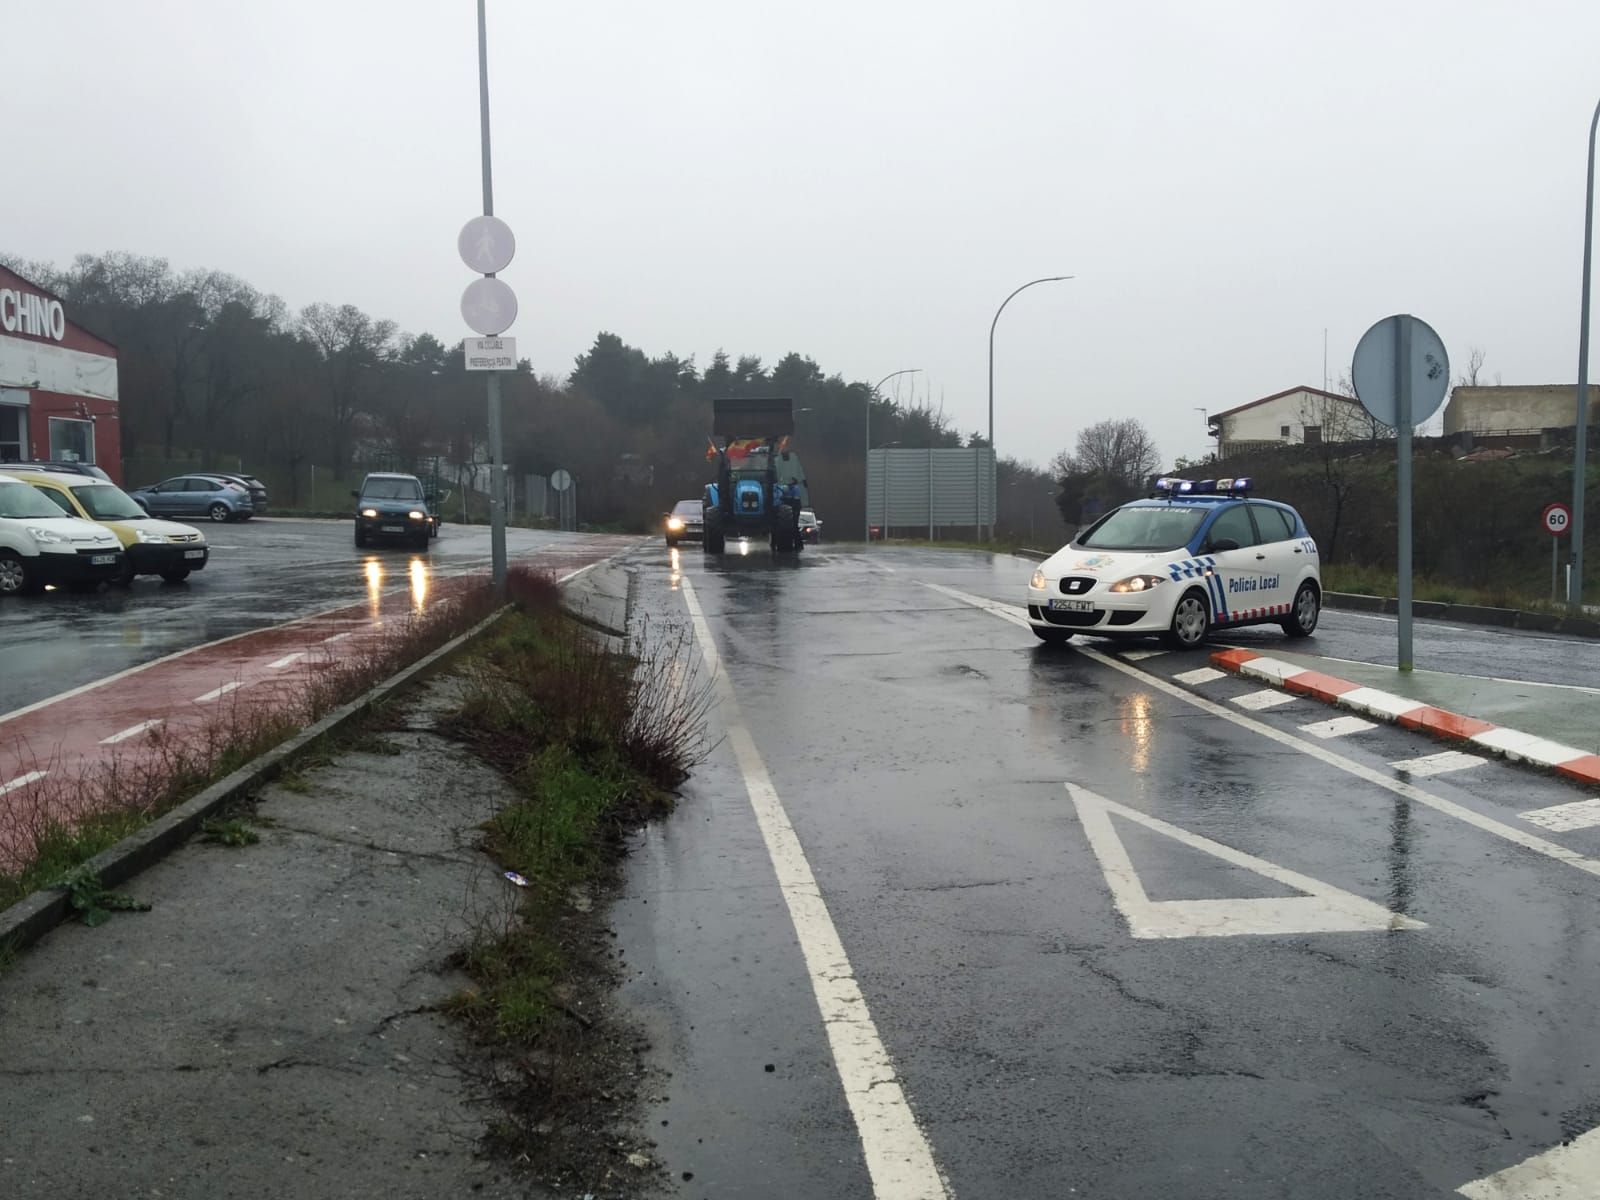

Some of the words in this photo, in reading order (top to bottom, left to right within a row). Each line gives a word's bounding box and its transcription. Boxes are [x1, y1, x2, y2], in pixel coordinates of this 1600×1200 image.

[0, 288, 65, 341] CHINO
[1549, 514, 1565, 525] 60
[1301, 541, 1316, 553] 112
[1229, 576, 1257, 593] Policía
[1259, 573, 1280, 590] Local
